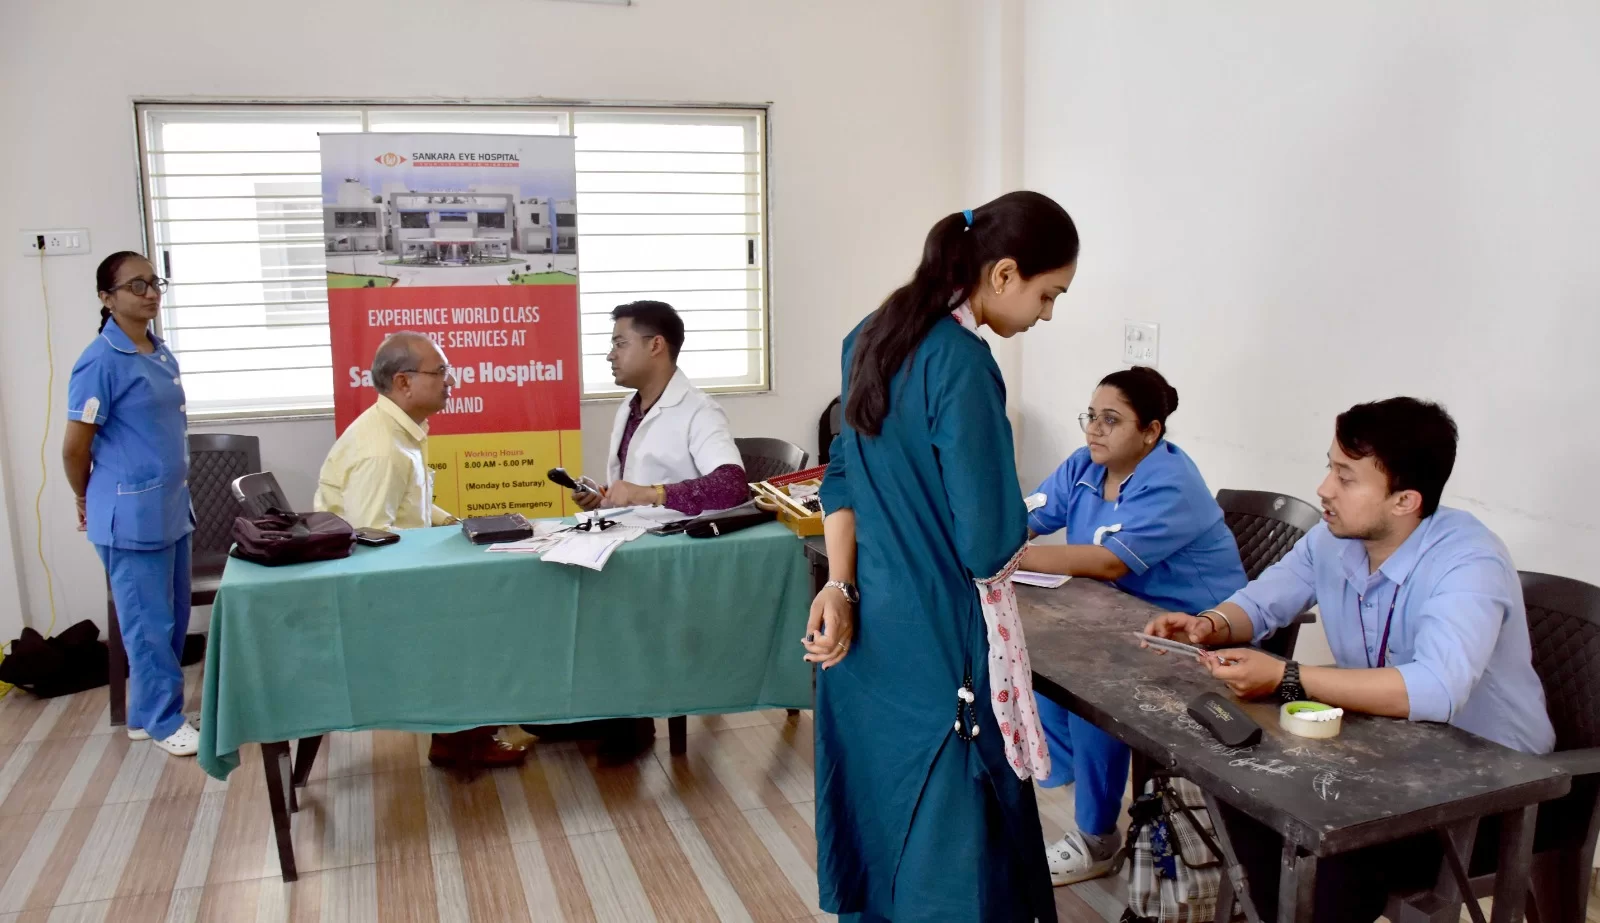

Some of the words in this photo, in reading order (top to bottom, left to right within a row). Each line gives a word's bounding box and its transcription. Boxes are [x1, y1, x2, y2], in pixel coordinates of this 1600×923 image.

[412, 152, 456, 161] SANKARA
[458, 152, 476, 161] EYE
[478, 152, 520, 162] HOSPITAL
[368, 308, 448, 327] EXPERIENCE
[452, 307, 500, 325] WORLD
[502, 306, 540, 324] CLASS
[448, 330, 508, 348] SERVICES
[511, 329, 527, 346] AT
[451, 366, 475, 389] ye
[479, 359, 563, 387] Hospital
[464, 450, 498, 459] Working
[500, 449, 524, 457] Hours
[464, 461, 481, 469] 8.00
[482, 460, 496, 468] AM
[503, 459, 519, 467] 6.00
[521, 458, 534, 466] PM
[465, 482, 500, 491] (Monday
[502, 481, 510, 489] to
[512, 479, 545, 489] Saturay)
[467, 501, 507, 511] SUNDAYS
[508, 500, 553, 510] Emergency
